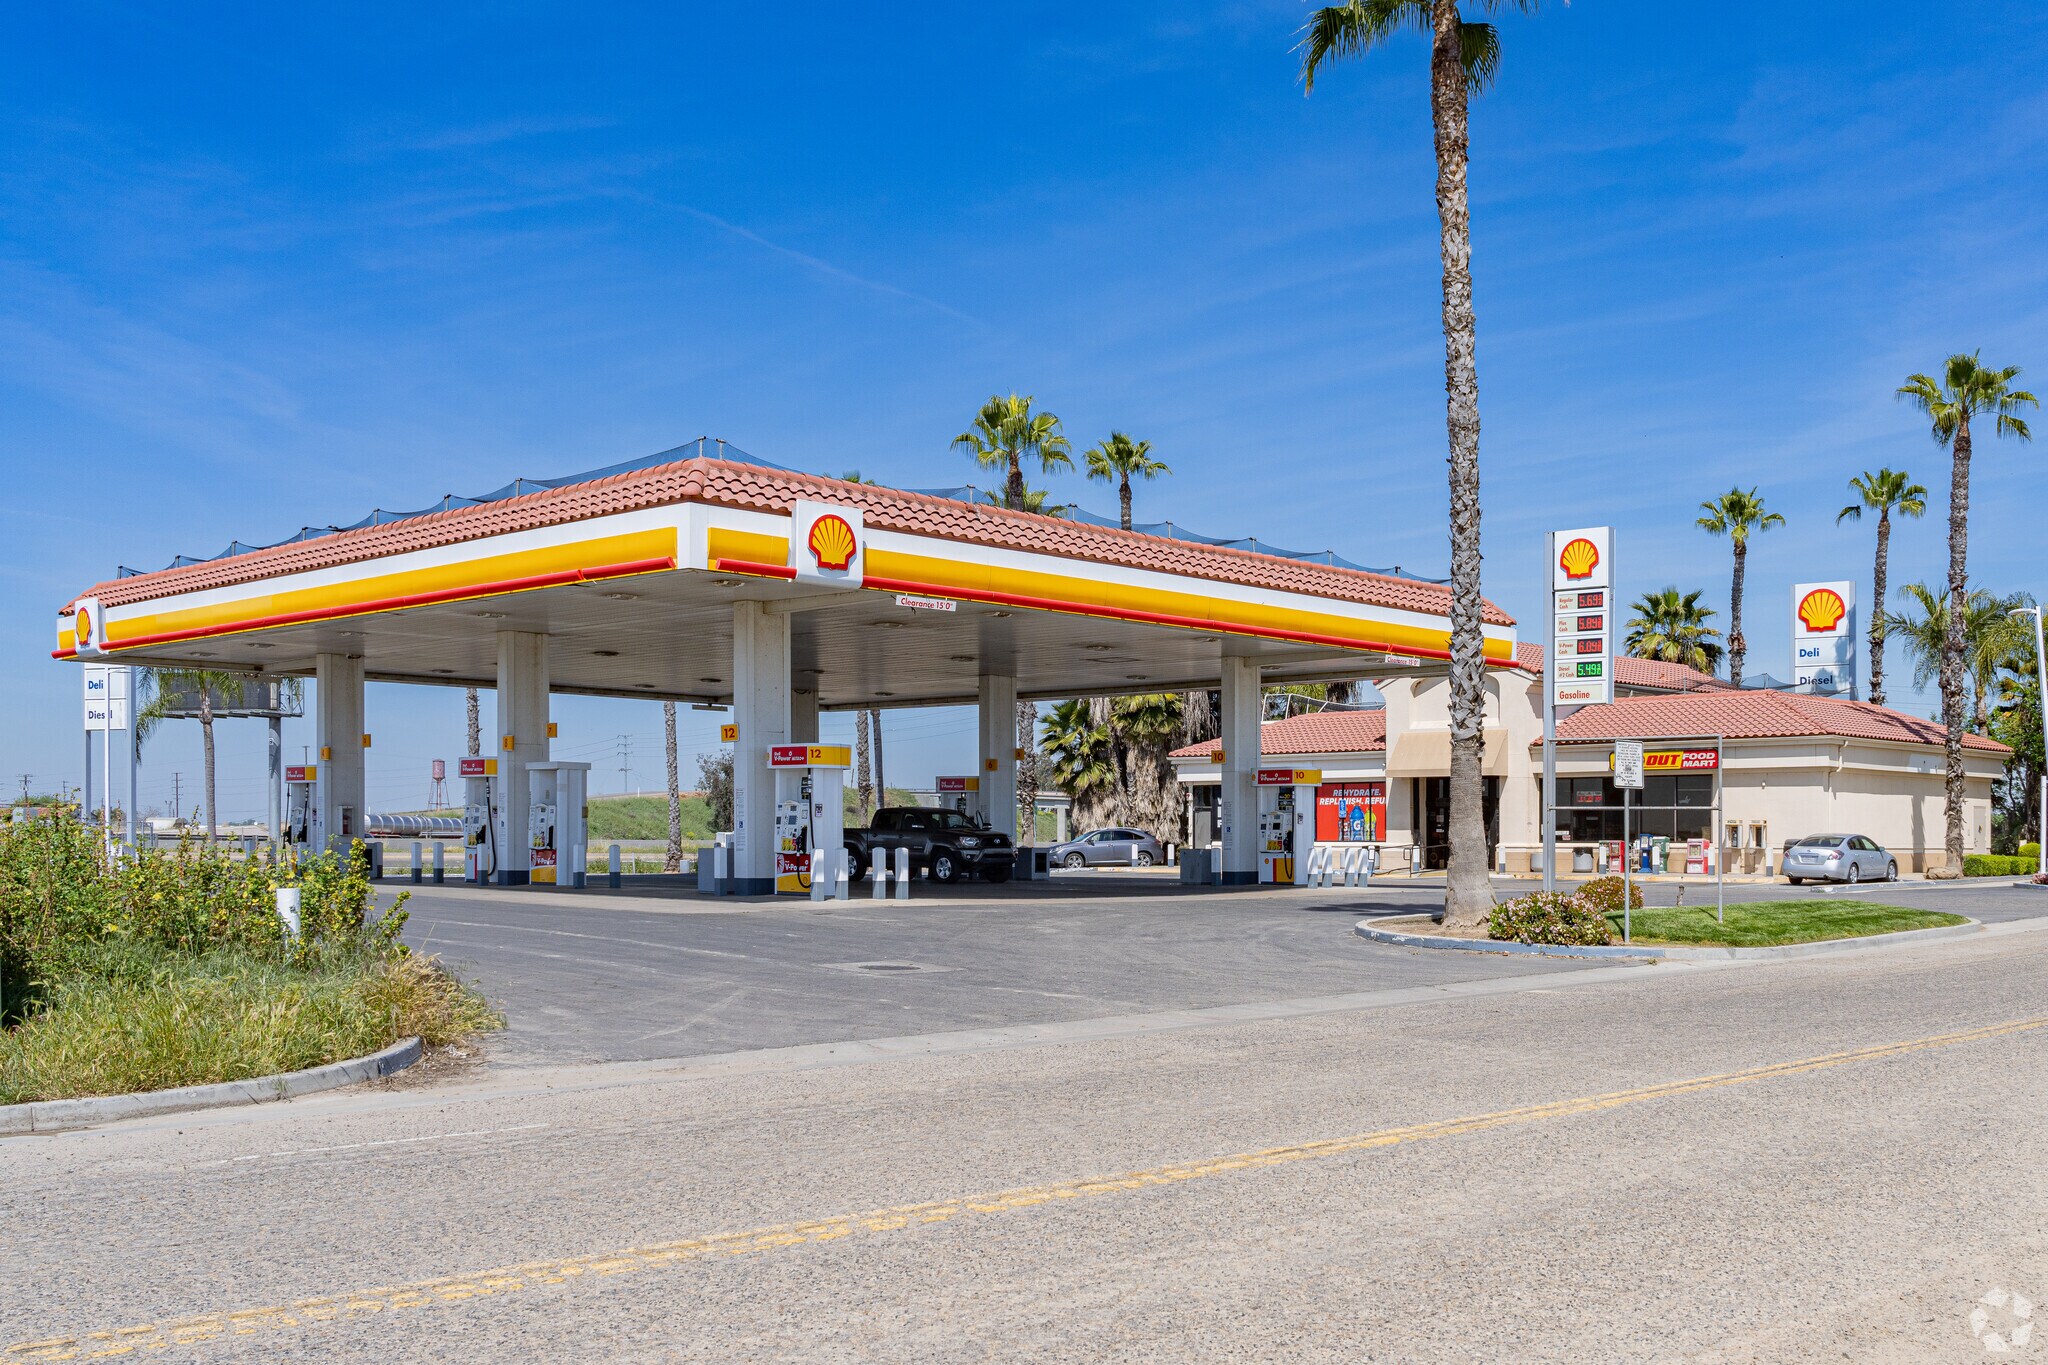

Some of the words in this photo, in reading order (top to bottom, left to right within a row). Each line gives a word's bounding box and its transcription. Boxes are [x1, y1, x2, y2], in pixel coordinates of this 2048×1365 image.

[901, 597, 934, 609] Clearance
[1800, 647, 1820, 658] Deli
[88, 679, 104, 690] Deli
[1800, 675, 1833, 685] Diesel
[1559, 690, 1591, 700] Gasoline
[88, 709, 113, 719] Diesl
[723, 727, 736, 739] 12
[810, 749, 822, 759] 12
[1213, 752, 1224, 761] 10
[1682, 752, 1716, 760] FOOD
[1295, 771, 1305, 779] 10
[1332, 788, 1382, 797] REHYDRATE.
[1319, 797, 1364, 806] REPLNISH.
[1353, 820, 1361, 831] G
